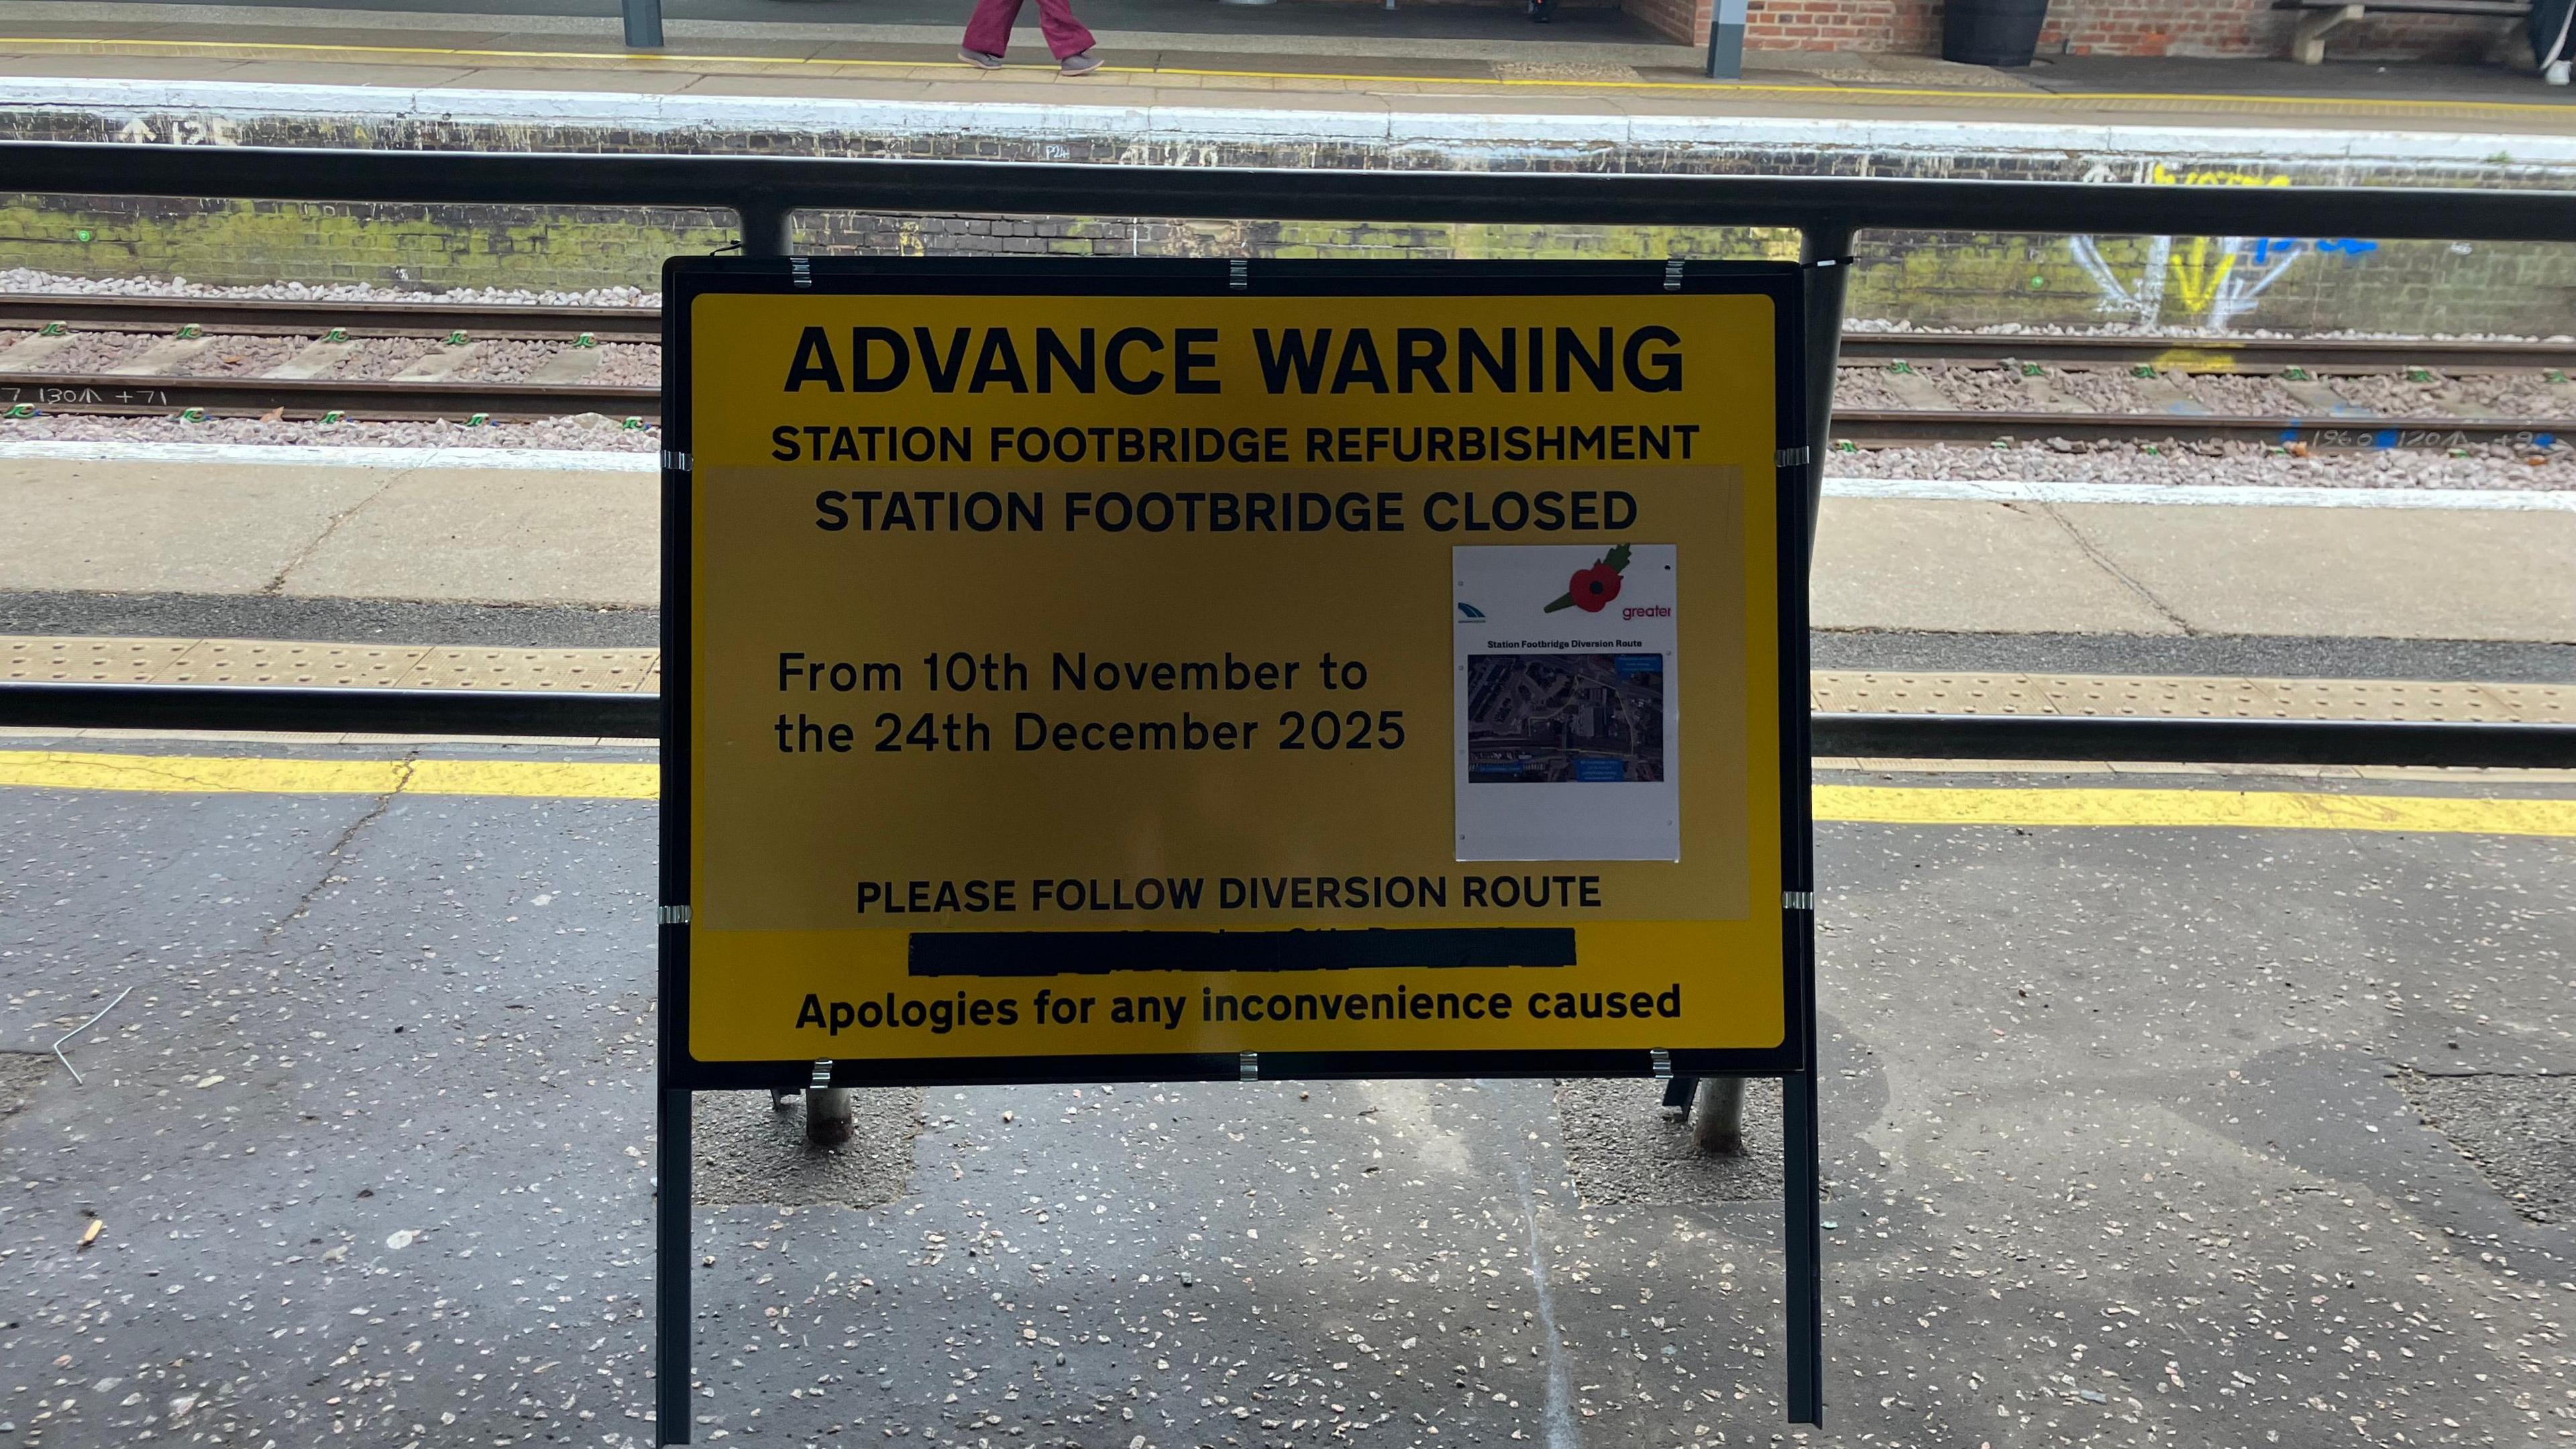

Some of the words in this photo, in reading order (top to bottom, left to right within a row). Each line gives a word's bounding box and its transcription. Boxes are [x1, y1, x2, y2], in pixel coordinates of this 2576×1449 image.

[784, 327, 1221, 395] ADVANCE
[1252, 326, 1682, 394] WARNING
[772, 426, 971, 462] STATION
[991, 427, 1289, 462] FOOTBRIDGE
[1307, 425, 1699, 462] REFURBISHMENT
[816, 491, 1042, 531] STATION
[1066, 492, 1404, 532] FOOTBRIDGE
[1424, 491, 1637, 531] CLOSED
[1623, 604, 1670, 621] greater
[1487, 640, 1519, 649] Station
[1521, 639, 1569, 649] Footbridge
[1571, 639, 1613, 649] Diversion
[1615, 639, 1642, 649] Route
[780, 653, 900, 692] From
[924, 652, 1027, 692] 10th
[1053, 652, 1299, 690] November
[1320, 653, 1366, 690] to
[775, 714, 853, 752] the
[875, 713, 989, 751] 24th
[1016, 712, 1258, 751] December
[1280, 710, 1404, 749] 2025
[858, 880, 1016, 913] PLEASE
[1033, 878, 1203, 910] FOLLOW
[1220, 876, 1446, 908] DIVERSION
[1464, 876, 1601, 907] ROUTE
[796, 993, 1018, 1036] Apologies
[1034, 991, 1095, 1024] for
[1111, 997, 1186, 1030] any
[1203, 985, 1511, 1021] inconvenience
[1529, 983, 1680, 1018] caused
